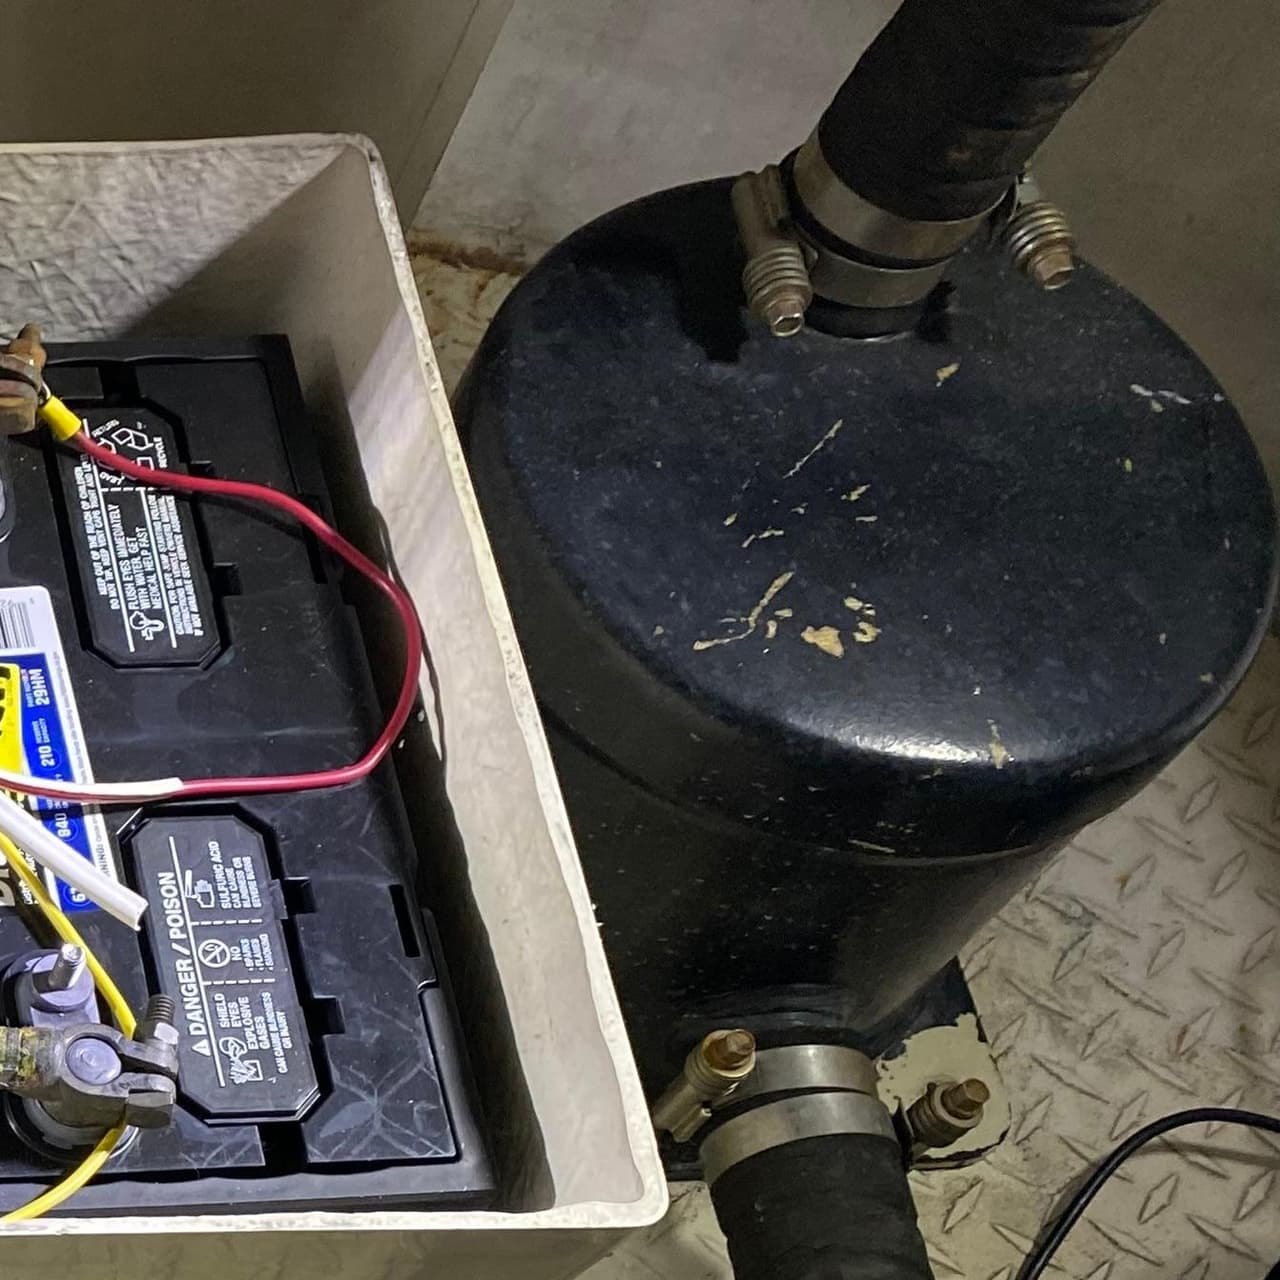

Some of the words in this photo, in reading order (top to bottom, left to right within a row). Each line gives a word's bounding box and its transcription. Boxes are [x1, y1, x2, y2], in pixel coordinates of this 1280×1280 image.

[108, 505, 128, 558] IMMEDIATELY
[136, 527, 149, 547] FAST
[127, 537, 139, 553] GET
[119, 561, 131, 581] EYES
[142, 549, 154, 570] HELP
[124, 584, 138, 609] FLUSH
[138, 588, 151, 609] WITH
[147, 572, 162, 608] MEDICAL
[28, 668, 50, 705] 29HM
[37, 746, 55, 766] 210
[54, 813, 70, 836] 840
[209, 842, 220, 861] ACID
[215, 865, 231, 909] SULFURIC
[158, 872, 186, 938] POISON
[230, 947, 241, 960] NO
[176, 959, 206, 1034] DANGER
[214, 994, 226, 1027] SHIELD
[228, 1002, 238, 1027] EYES
[238, 997, 253, 1049] EXPLOSIVE
[254, 1016, 269, 1048] GASES
